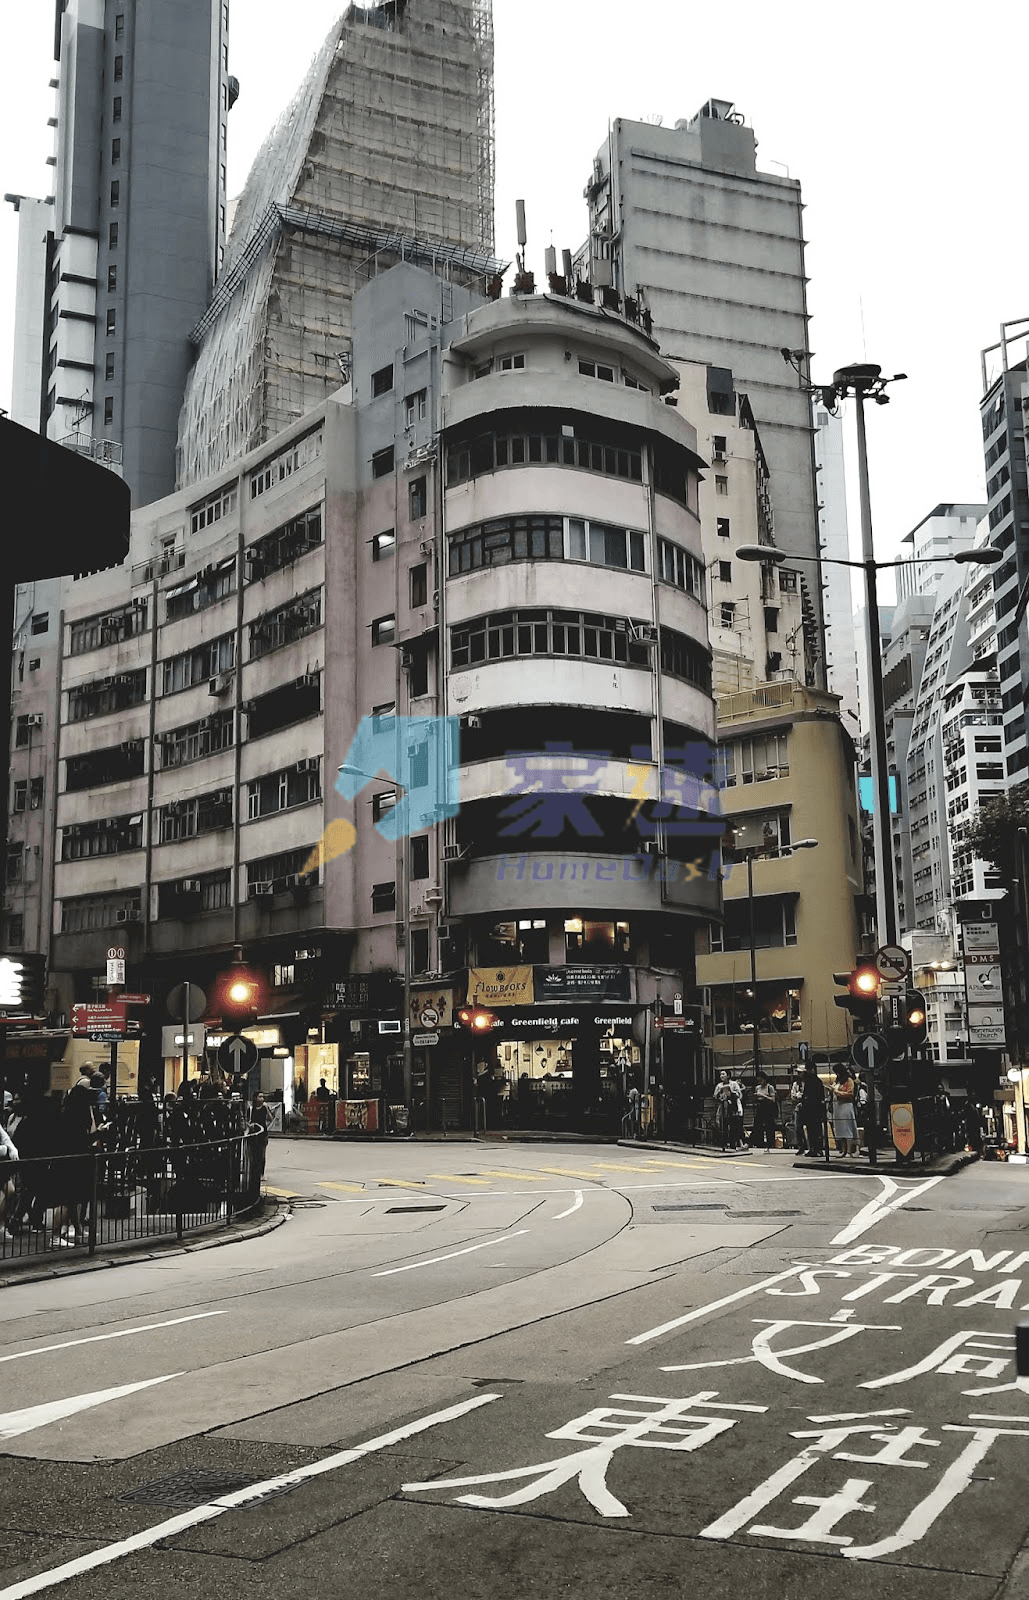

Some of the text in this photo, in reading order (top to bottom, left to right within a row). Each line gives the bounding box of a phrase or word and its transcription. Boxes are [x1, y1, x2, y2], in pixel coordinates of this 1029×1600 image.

[511, 1017, 579, 1026] Greenfield cafe
[594, 1017, 632, 1025] Greenfield
[764, 1270, 1029, 1310] STRA
